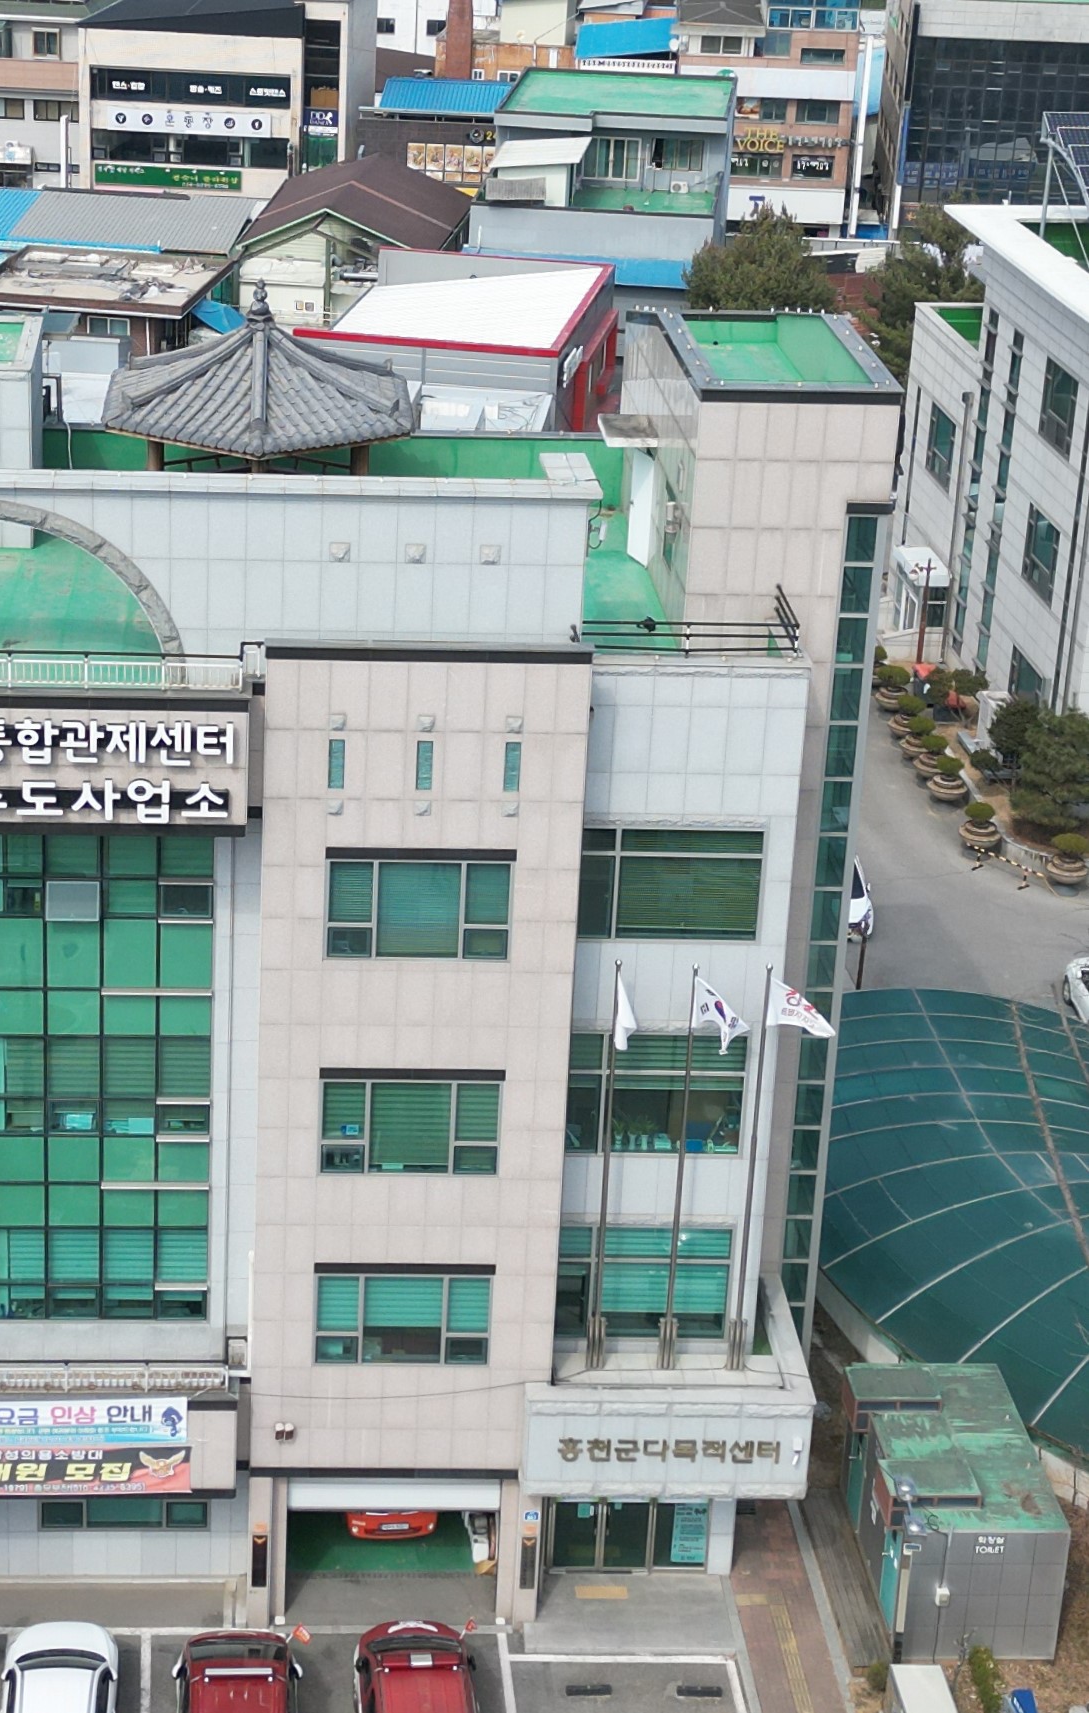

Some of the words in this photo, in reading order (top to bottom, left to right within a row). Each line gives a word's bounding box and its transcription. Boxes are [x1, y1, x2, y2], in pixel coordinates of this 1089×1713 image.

[744, 127, 778, 139] THE
[736, 138, 785, 152] VOICE
[50, 1406, 97, 1425] 인상
[106, 1404, 153, 1424] 안내
[558, 1437, 781, 1464] 홍천군다목적센터
[64, 1463, 132, 1481] 모집
